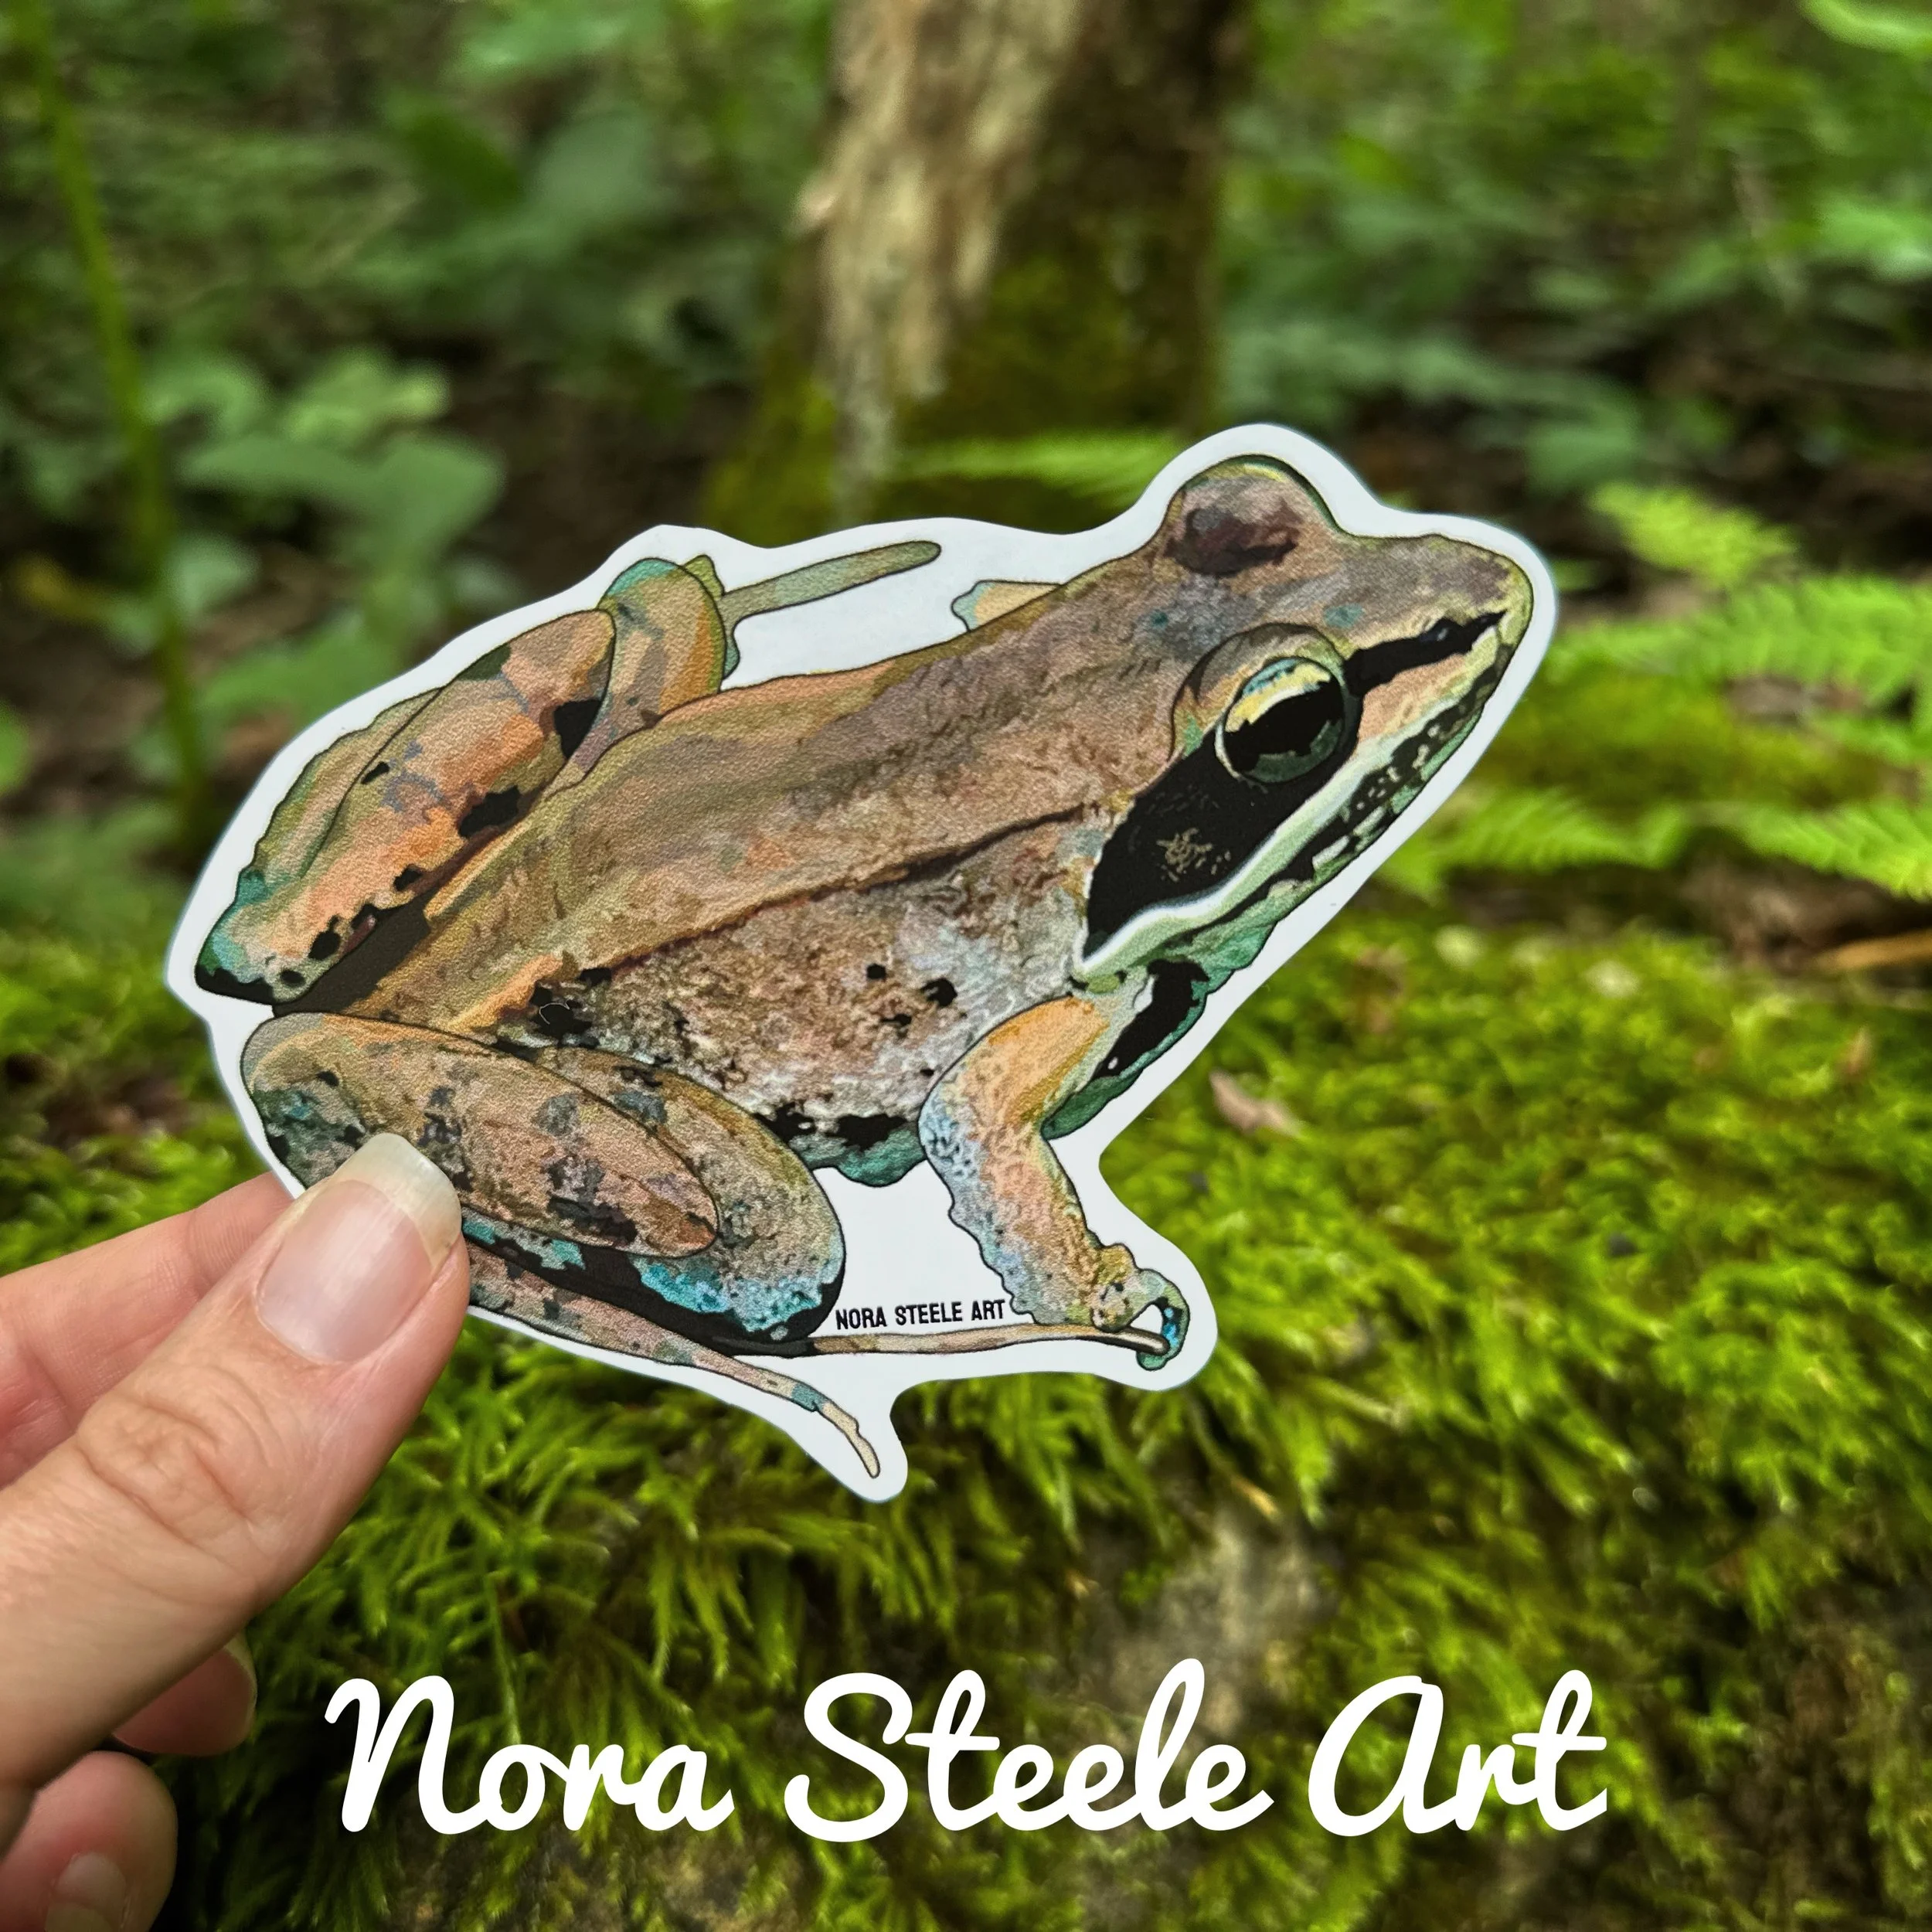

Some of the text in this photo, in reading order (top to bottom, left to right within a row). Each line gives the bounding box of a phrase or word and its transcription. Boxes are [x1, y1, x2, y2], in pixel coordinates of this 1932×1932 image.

[835, 1298, 1005, 1330] NORA STEELE ART
